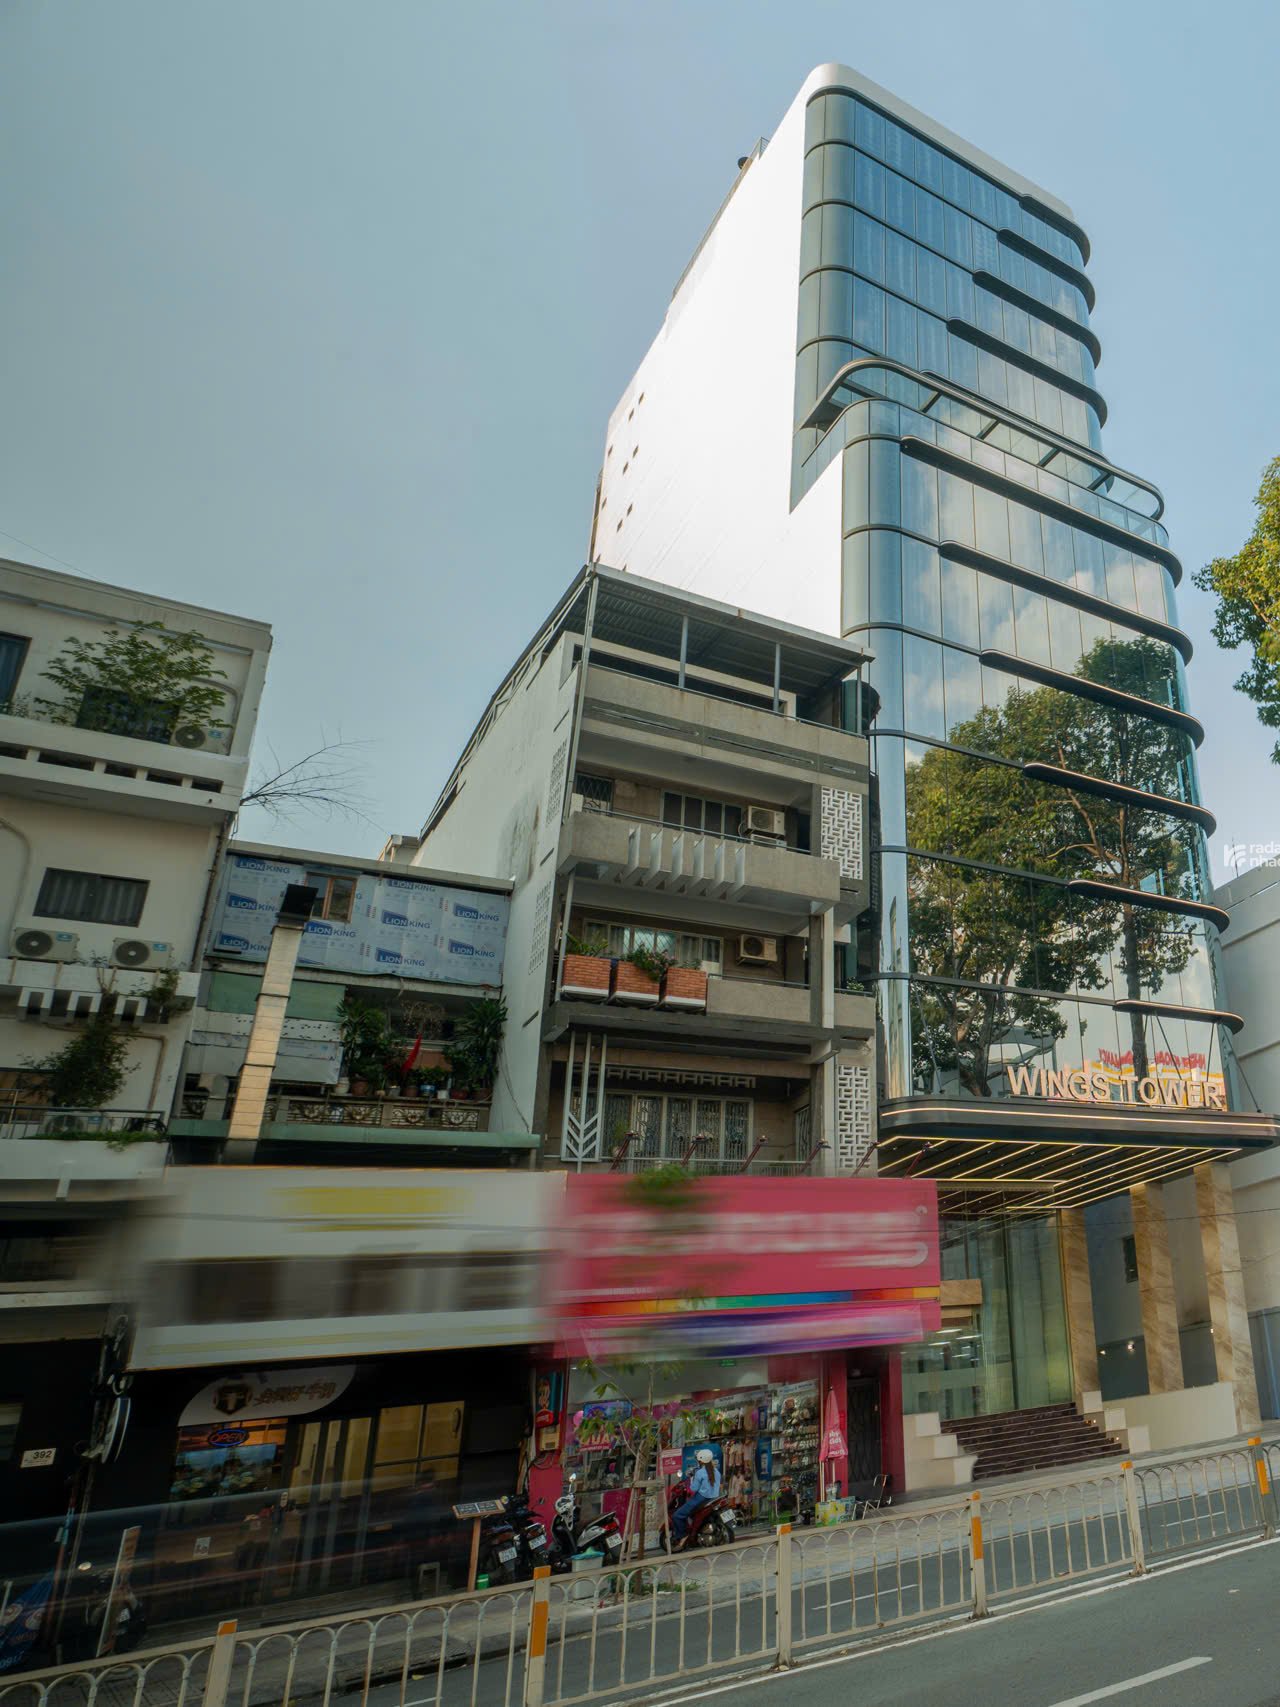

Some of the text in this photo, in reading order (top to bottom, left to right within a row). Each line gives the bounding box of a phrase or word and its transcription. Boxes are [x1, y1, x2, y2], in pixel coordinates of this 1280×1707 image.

[239, 861, 290, 874] LION KING
[391, 880, 413, 889] LION
[231, 900, 276, 912] LION KIN
[457, 910, 500, 922] LION KING
[385, 917, 431, 929] LION KING
[308, 926, 357, 938] LION KING
[250, 943, 268, 952] KIN
[452, 947, 496, 958] LION KING
[379, 955, 425, 967] LION KING
[1006, 1065, 1224, 1108] WINGS TOWER
[33, 1450, 52, 1460] 392
